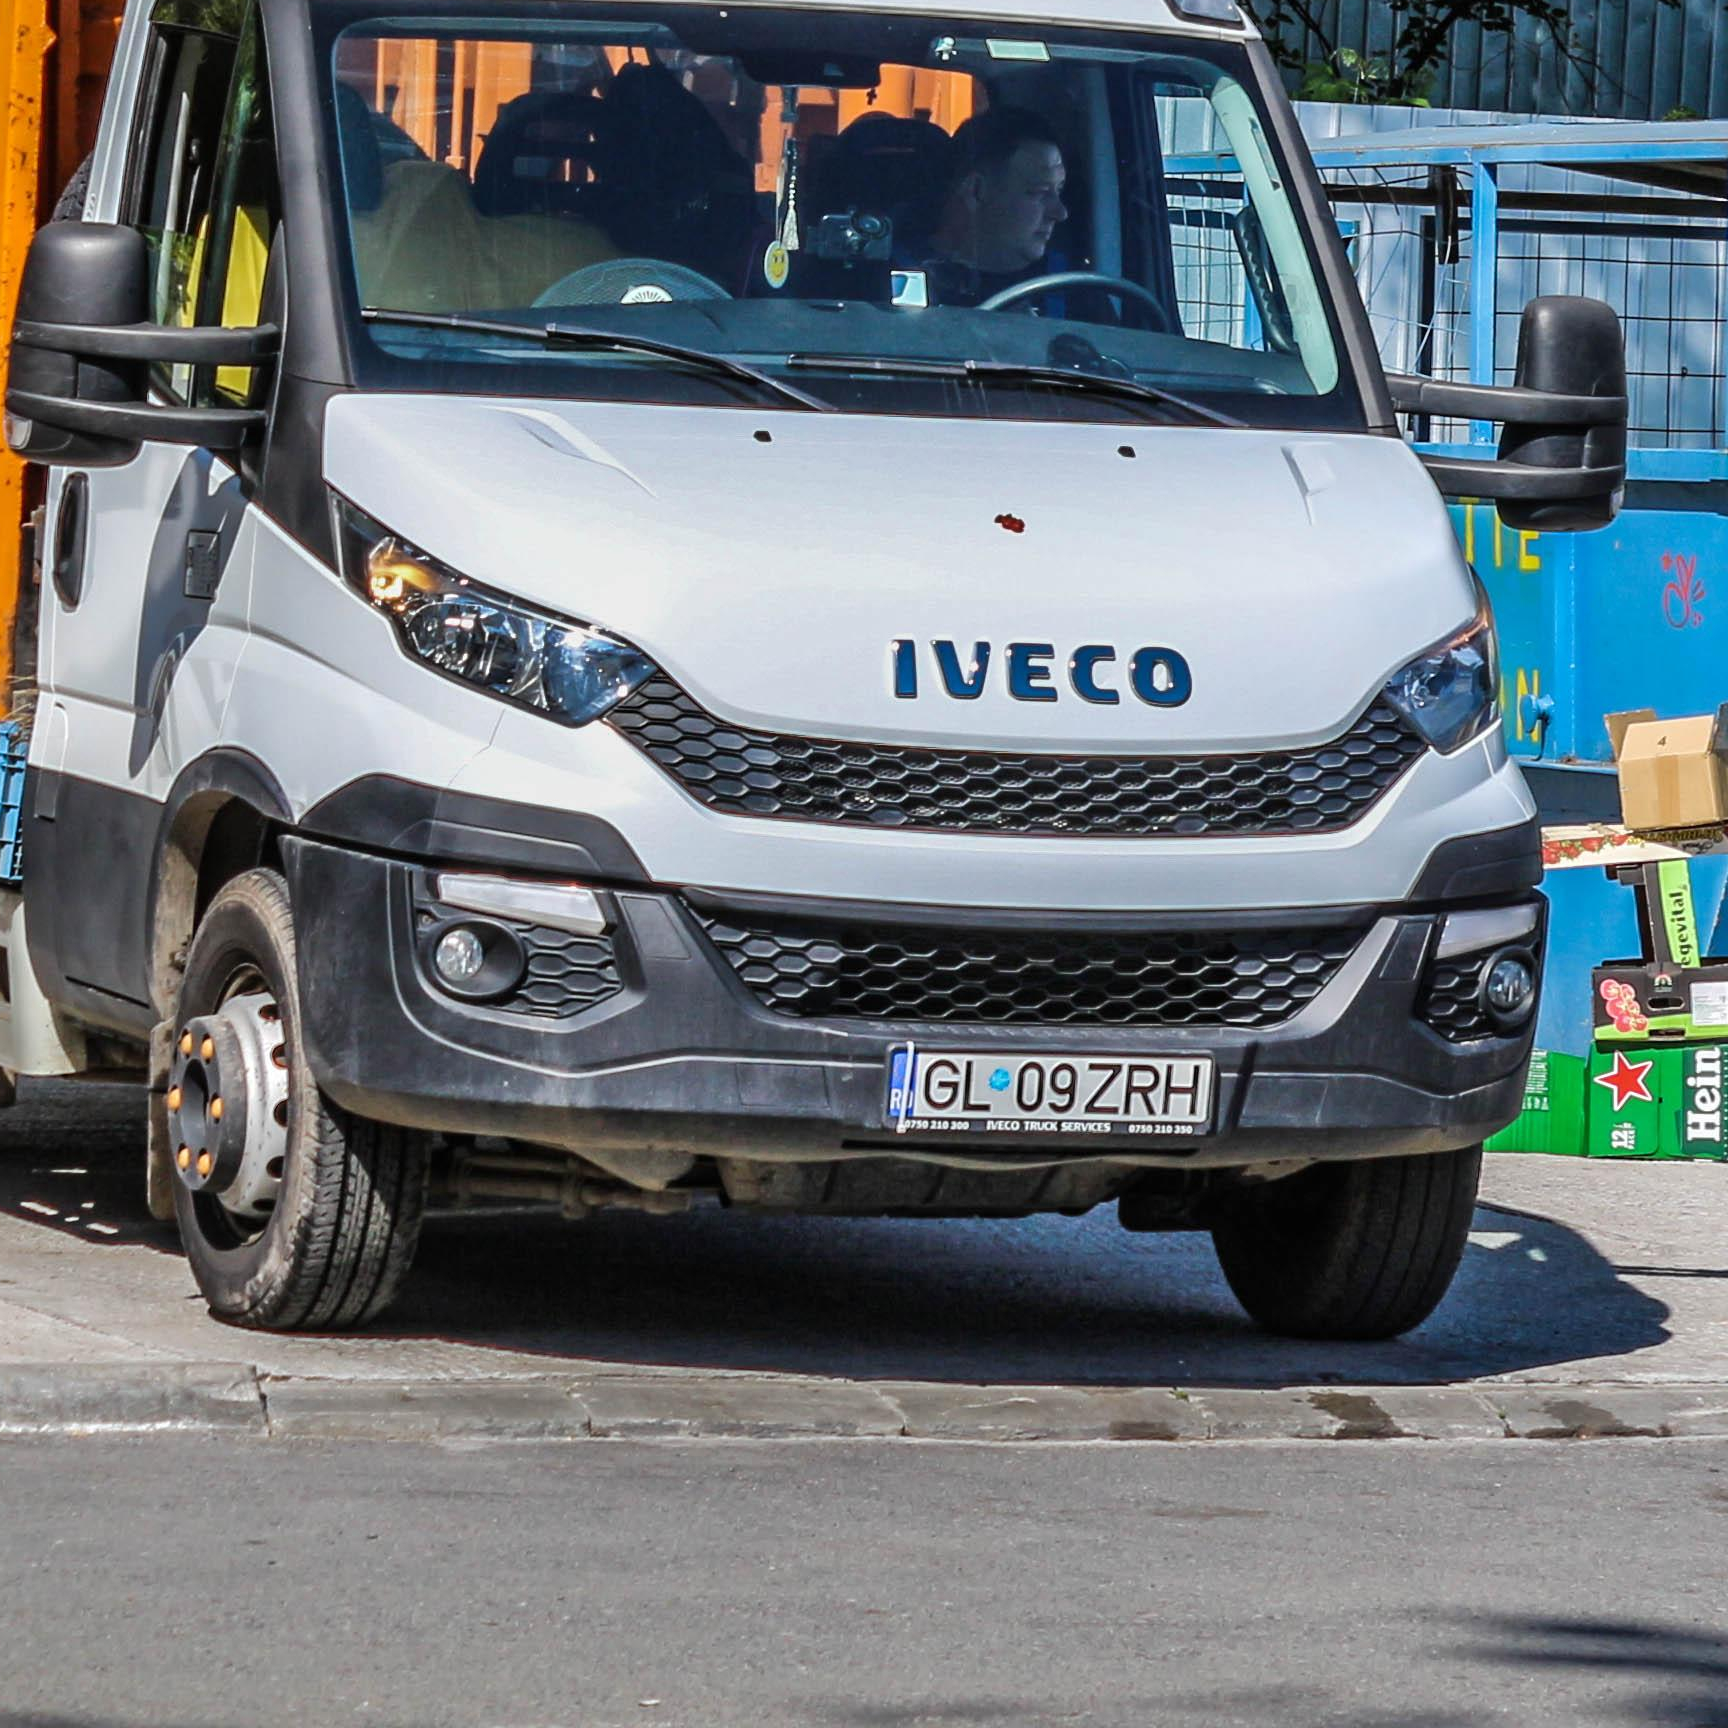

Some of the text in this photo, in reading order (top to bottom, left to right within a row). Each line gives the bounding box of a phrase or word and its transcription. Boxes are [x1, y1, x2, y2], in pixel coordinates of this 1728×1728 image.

[891, 639, 1193, 708] IVECO
[923, 1058, 992, 1113] GL
[986, 1120, 1021, 1132] IVECO
[1023, 1120, 1058, 1133] TRUCK
[1060, 1121, 1112, 1134] SERVICES
